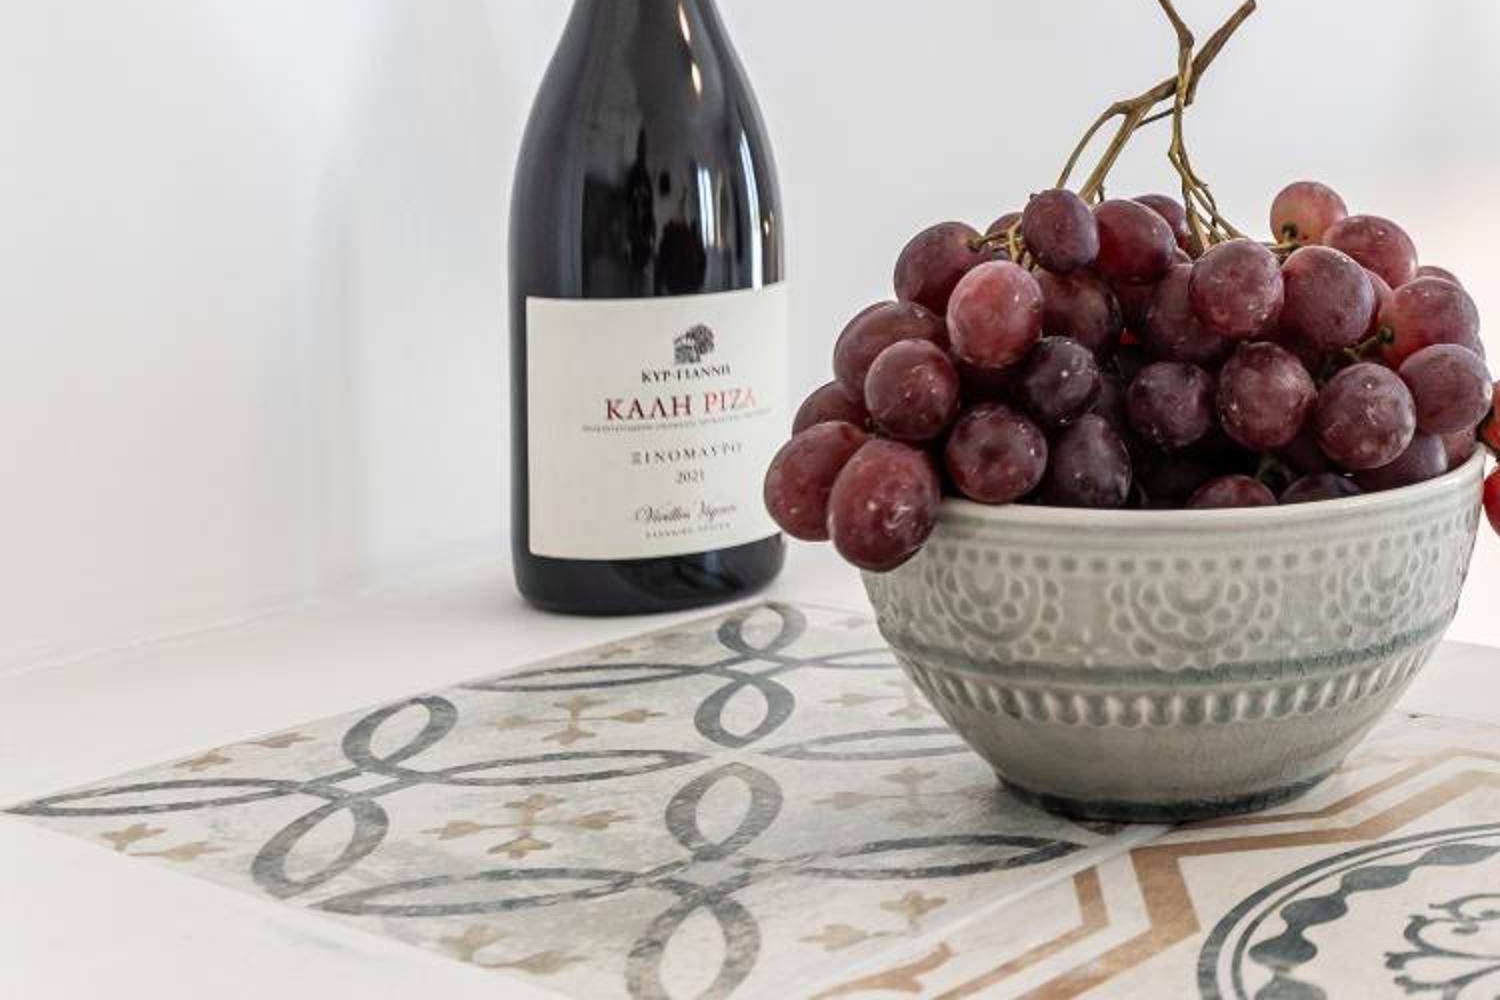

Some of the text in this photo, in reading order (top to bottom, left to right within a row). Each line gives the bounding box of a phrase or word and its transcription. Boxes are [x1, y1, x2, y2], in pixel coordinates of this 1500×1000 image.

[606, 386, 757, 420] ΚΑΛΗ ΡΙΖΑ
[631, 442, 742, 464] ΞΙΝΟΜΑΥΡΟ
